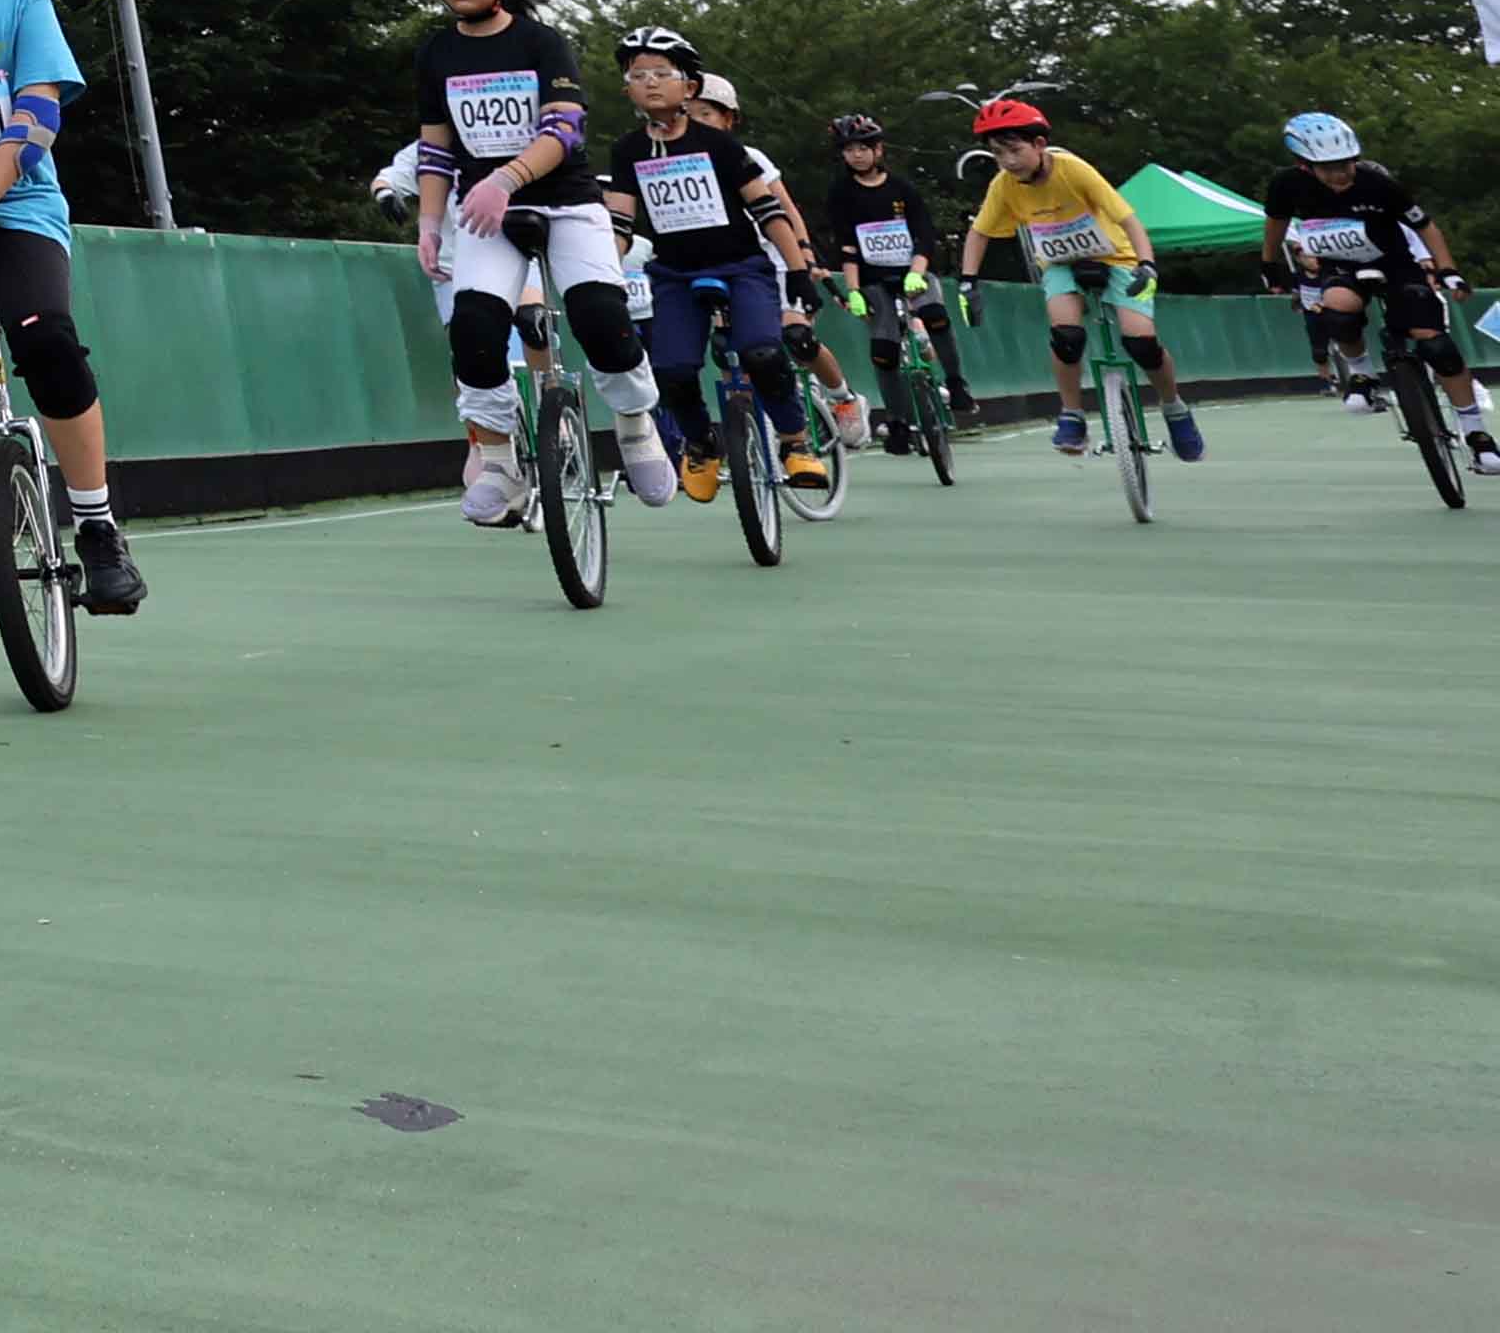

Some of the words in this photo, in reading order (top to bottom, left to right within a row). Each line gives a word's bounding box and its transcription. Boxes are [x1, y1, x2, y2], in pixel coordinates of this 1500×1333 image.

[461, 96, 533, 129] 04201
[647, 175, 713, 207] 02101
[865, 233, 910, 252] 05202
[1042, 229, 1101, 258] 03101
[1307, 230, 1365, 254] 04103
